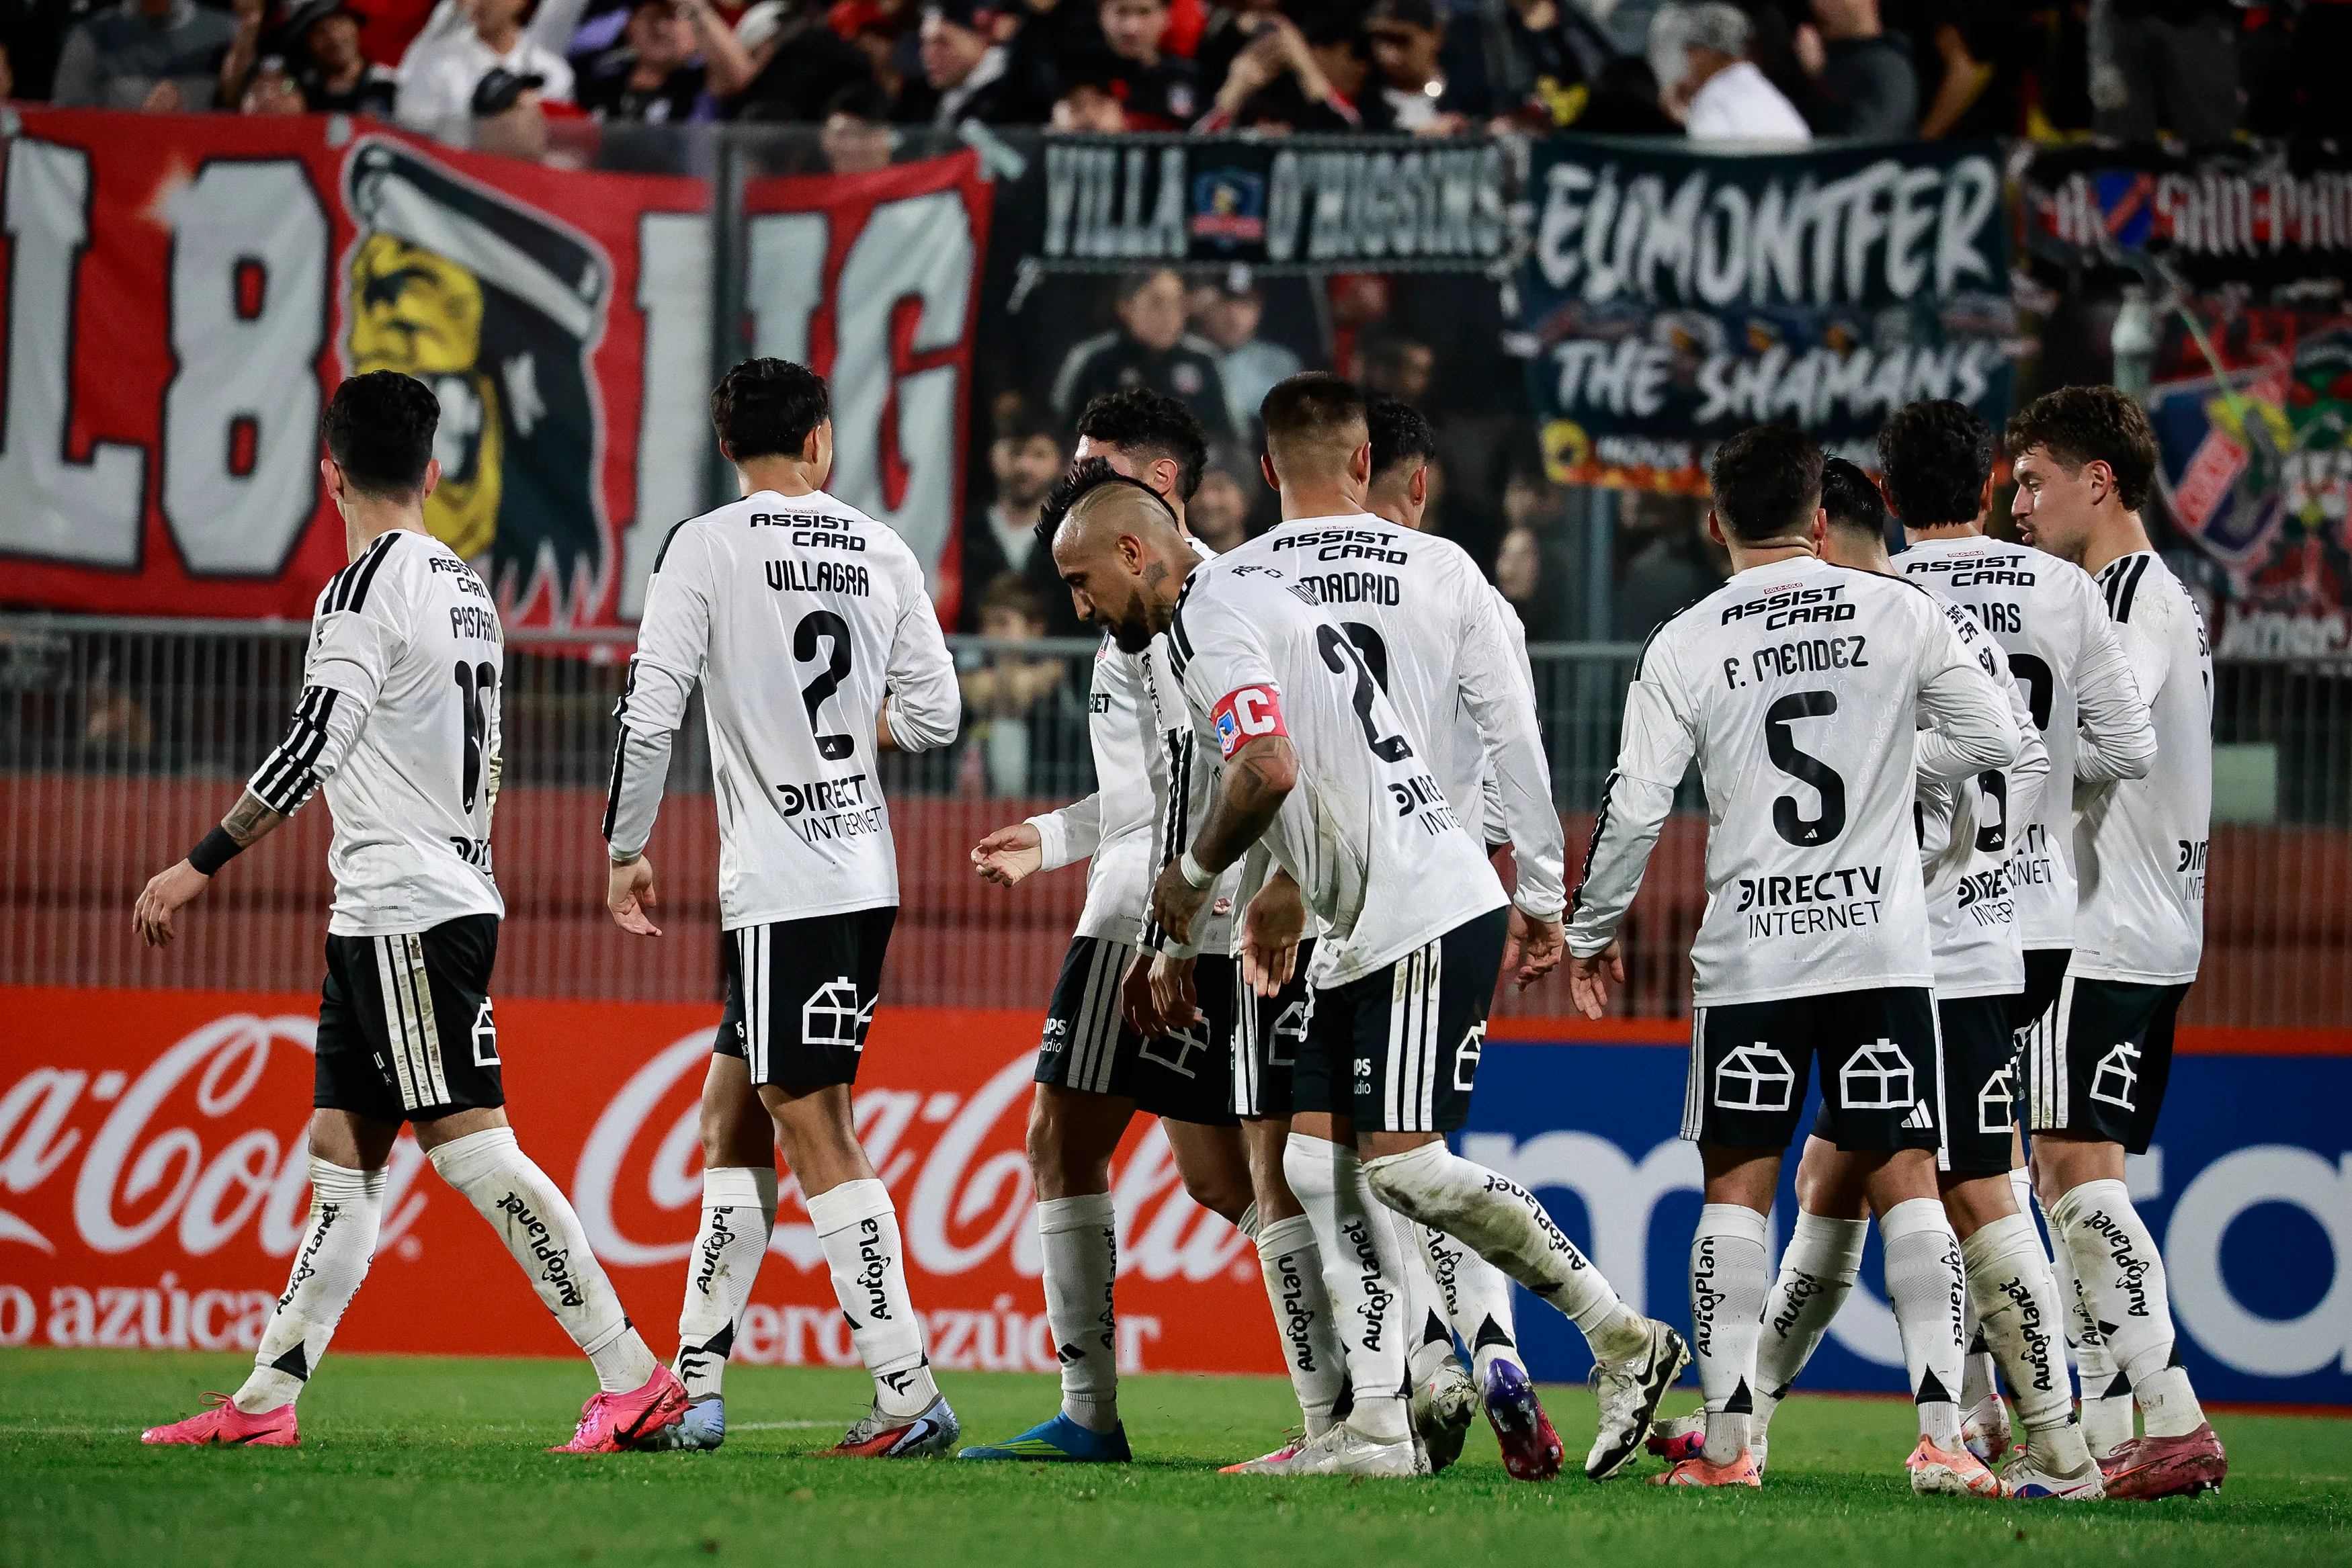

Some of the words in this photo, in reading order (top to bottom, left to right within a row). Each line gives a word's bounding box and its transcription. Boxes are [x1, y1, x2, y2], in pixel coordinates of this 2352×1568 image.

[1044, 144, 1187, 257] VILLA
[1551, 336, 1671, 418] THE
[1691, 339, 1994, 431] SHAMANS
[749, 513, 855, 531] ASSIST
[792, 531, 866, 552] CARD
[1272, 529, 1398, 552] ASSIST
[1318, 544, 1409, 566] CARD
[1906, 556, 2027, 574] ASSIST
[765, 560, 870, 598] VILLAGRA
[1298, 572, 1400, 607] MADRID
[1764, 582, 1804, 595] COLO-COLO
[1950, 570, 2036, 587] CARD
[1721, 584, 1845, 627] ASSIST
[1766, 603, 1856, 631] CARD
[1723, 657, 1747, 690] F.
[1753, 635, 1869, 683] MENDEZ
[793, 609, 855, 761] 2
[1234, 689, 1276, 736] C
[1765, 690, 1847, 848] 5
[802, 805, 884, 842] INTERNET
[1736, 865, 1882, 913] DIRECTV
[1749, 900, 1881, 939] INTERNET
[276, 1202, 341, 1315] AutoPlanet
[496, 1190, 585, 1307] AutoPlanet
[2083, 1209, 2149, 1317] AutoPlanet
[1341, 1219, 1394, 1352] AutoPlanet
